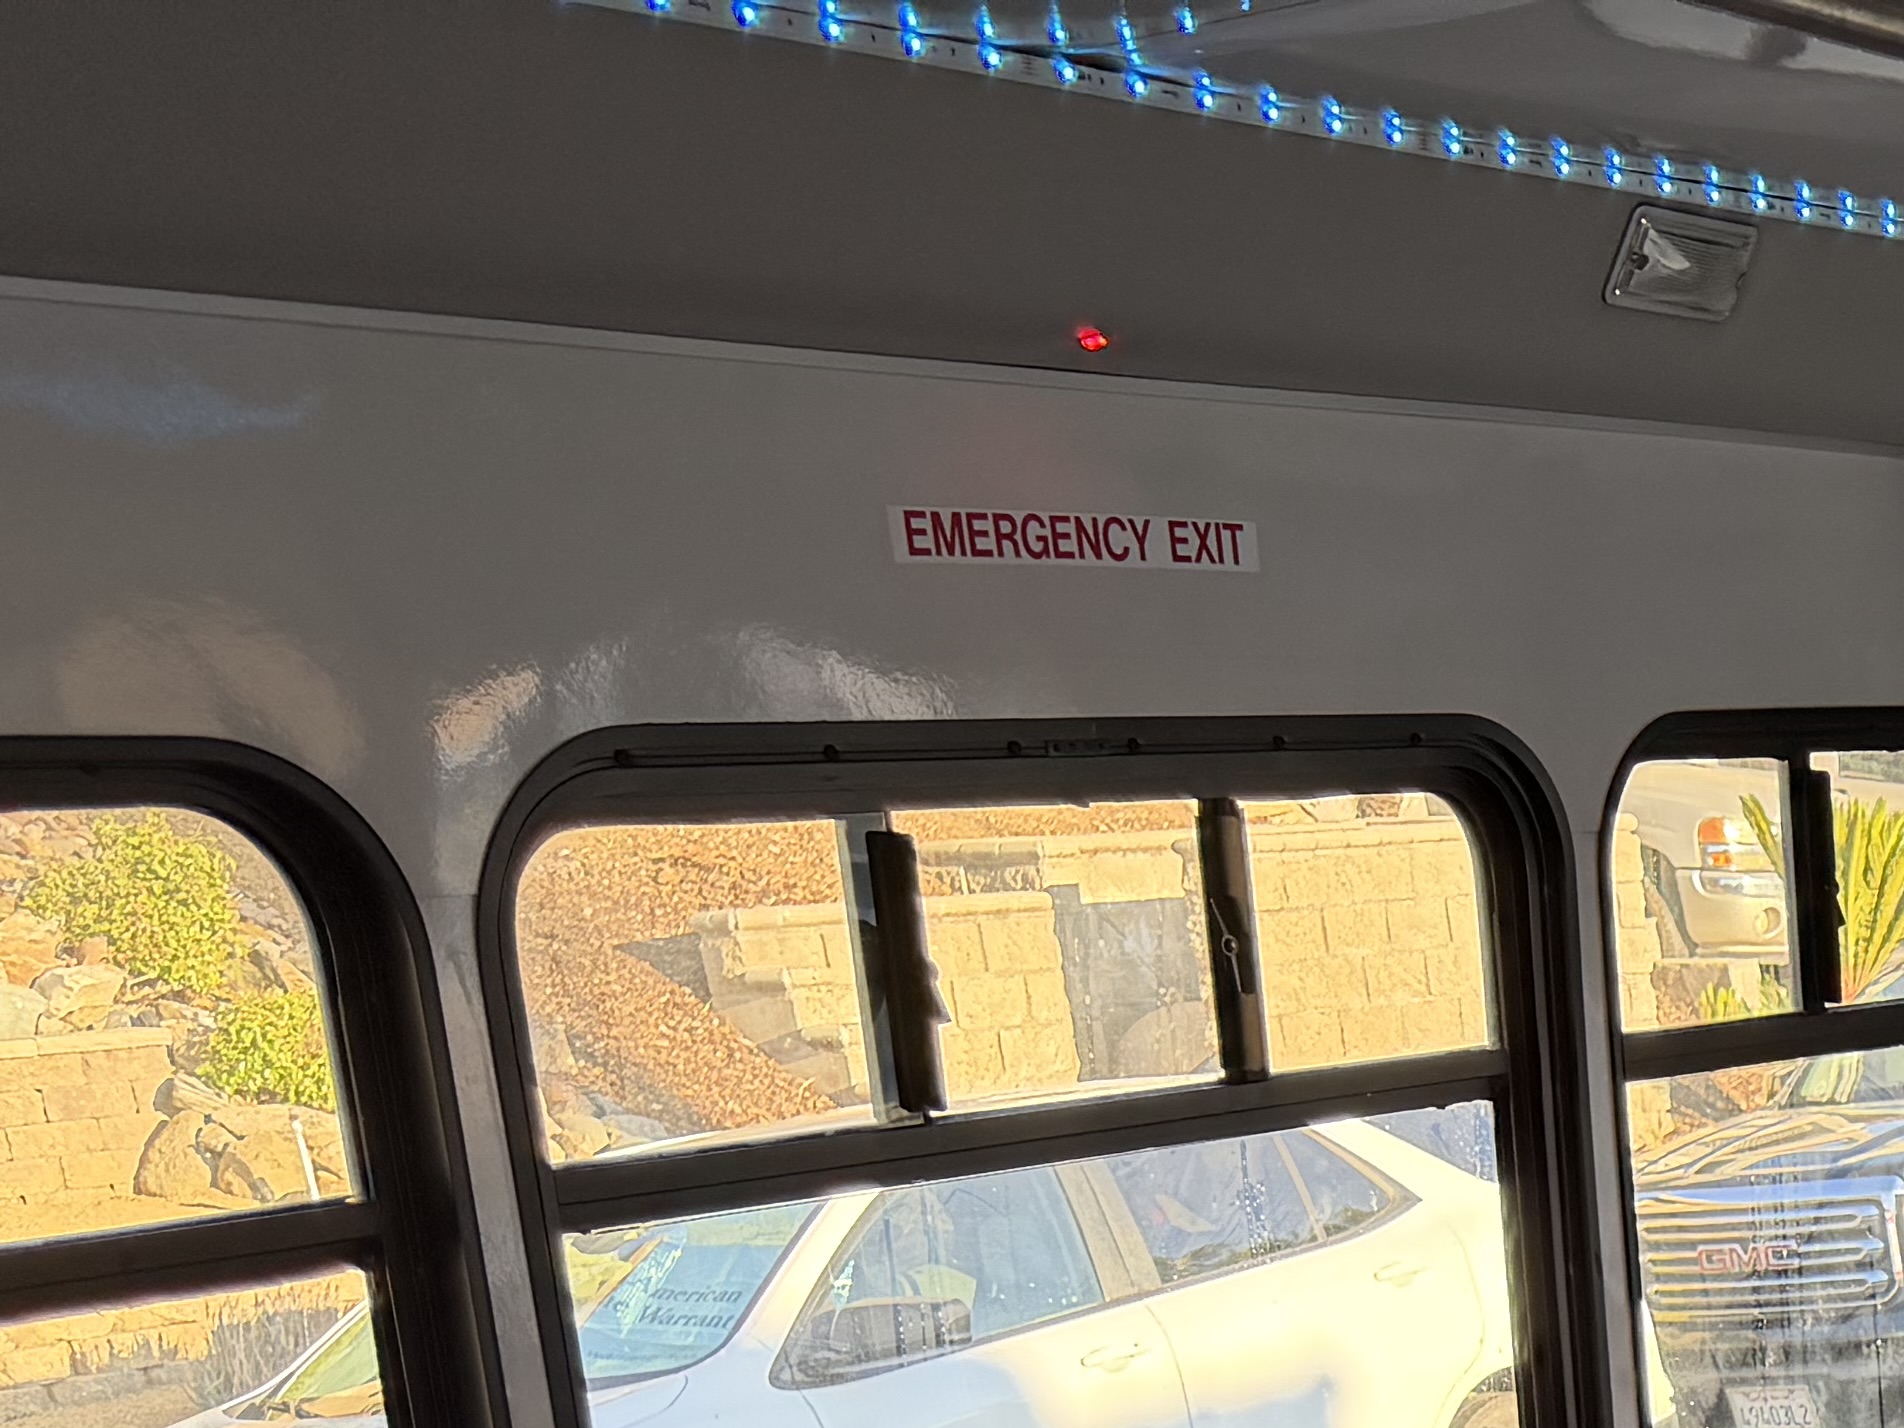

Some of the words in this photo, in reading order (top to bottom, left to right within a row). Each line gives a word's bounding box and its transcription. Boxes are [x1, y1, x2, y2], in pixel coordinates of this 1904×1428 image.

[903, 510, 1151, 562] EMERGENCY
[1167, 519, 1243, 566] EXIT
[1697, 1239, 1800, 1275] GMC
